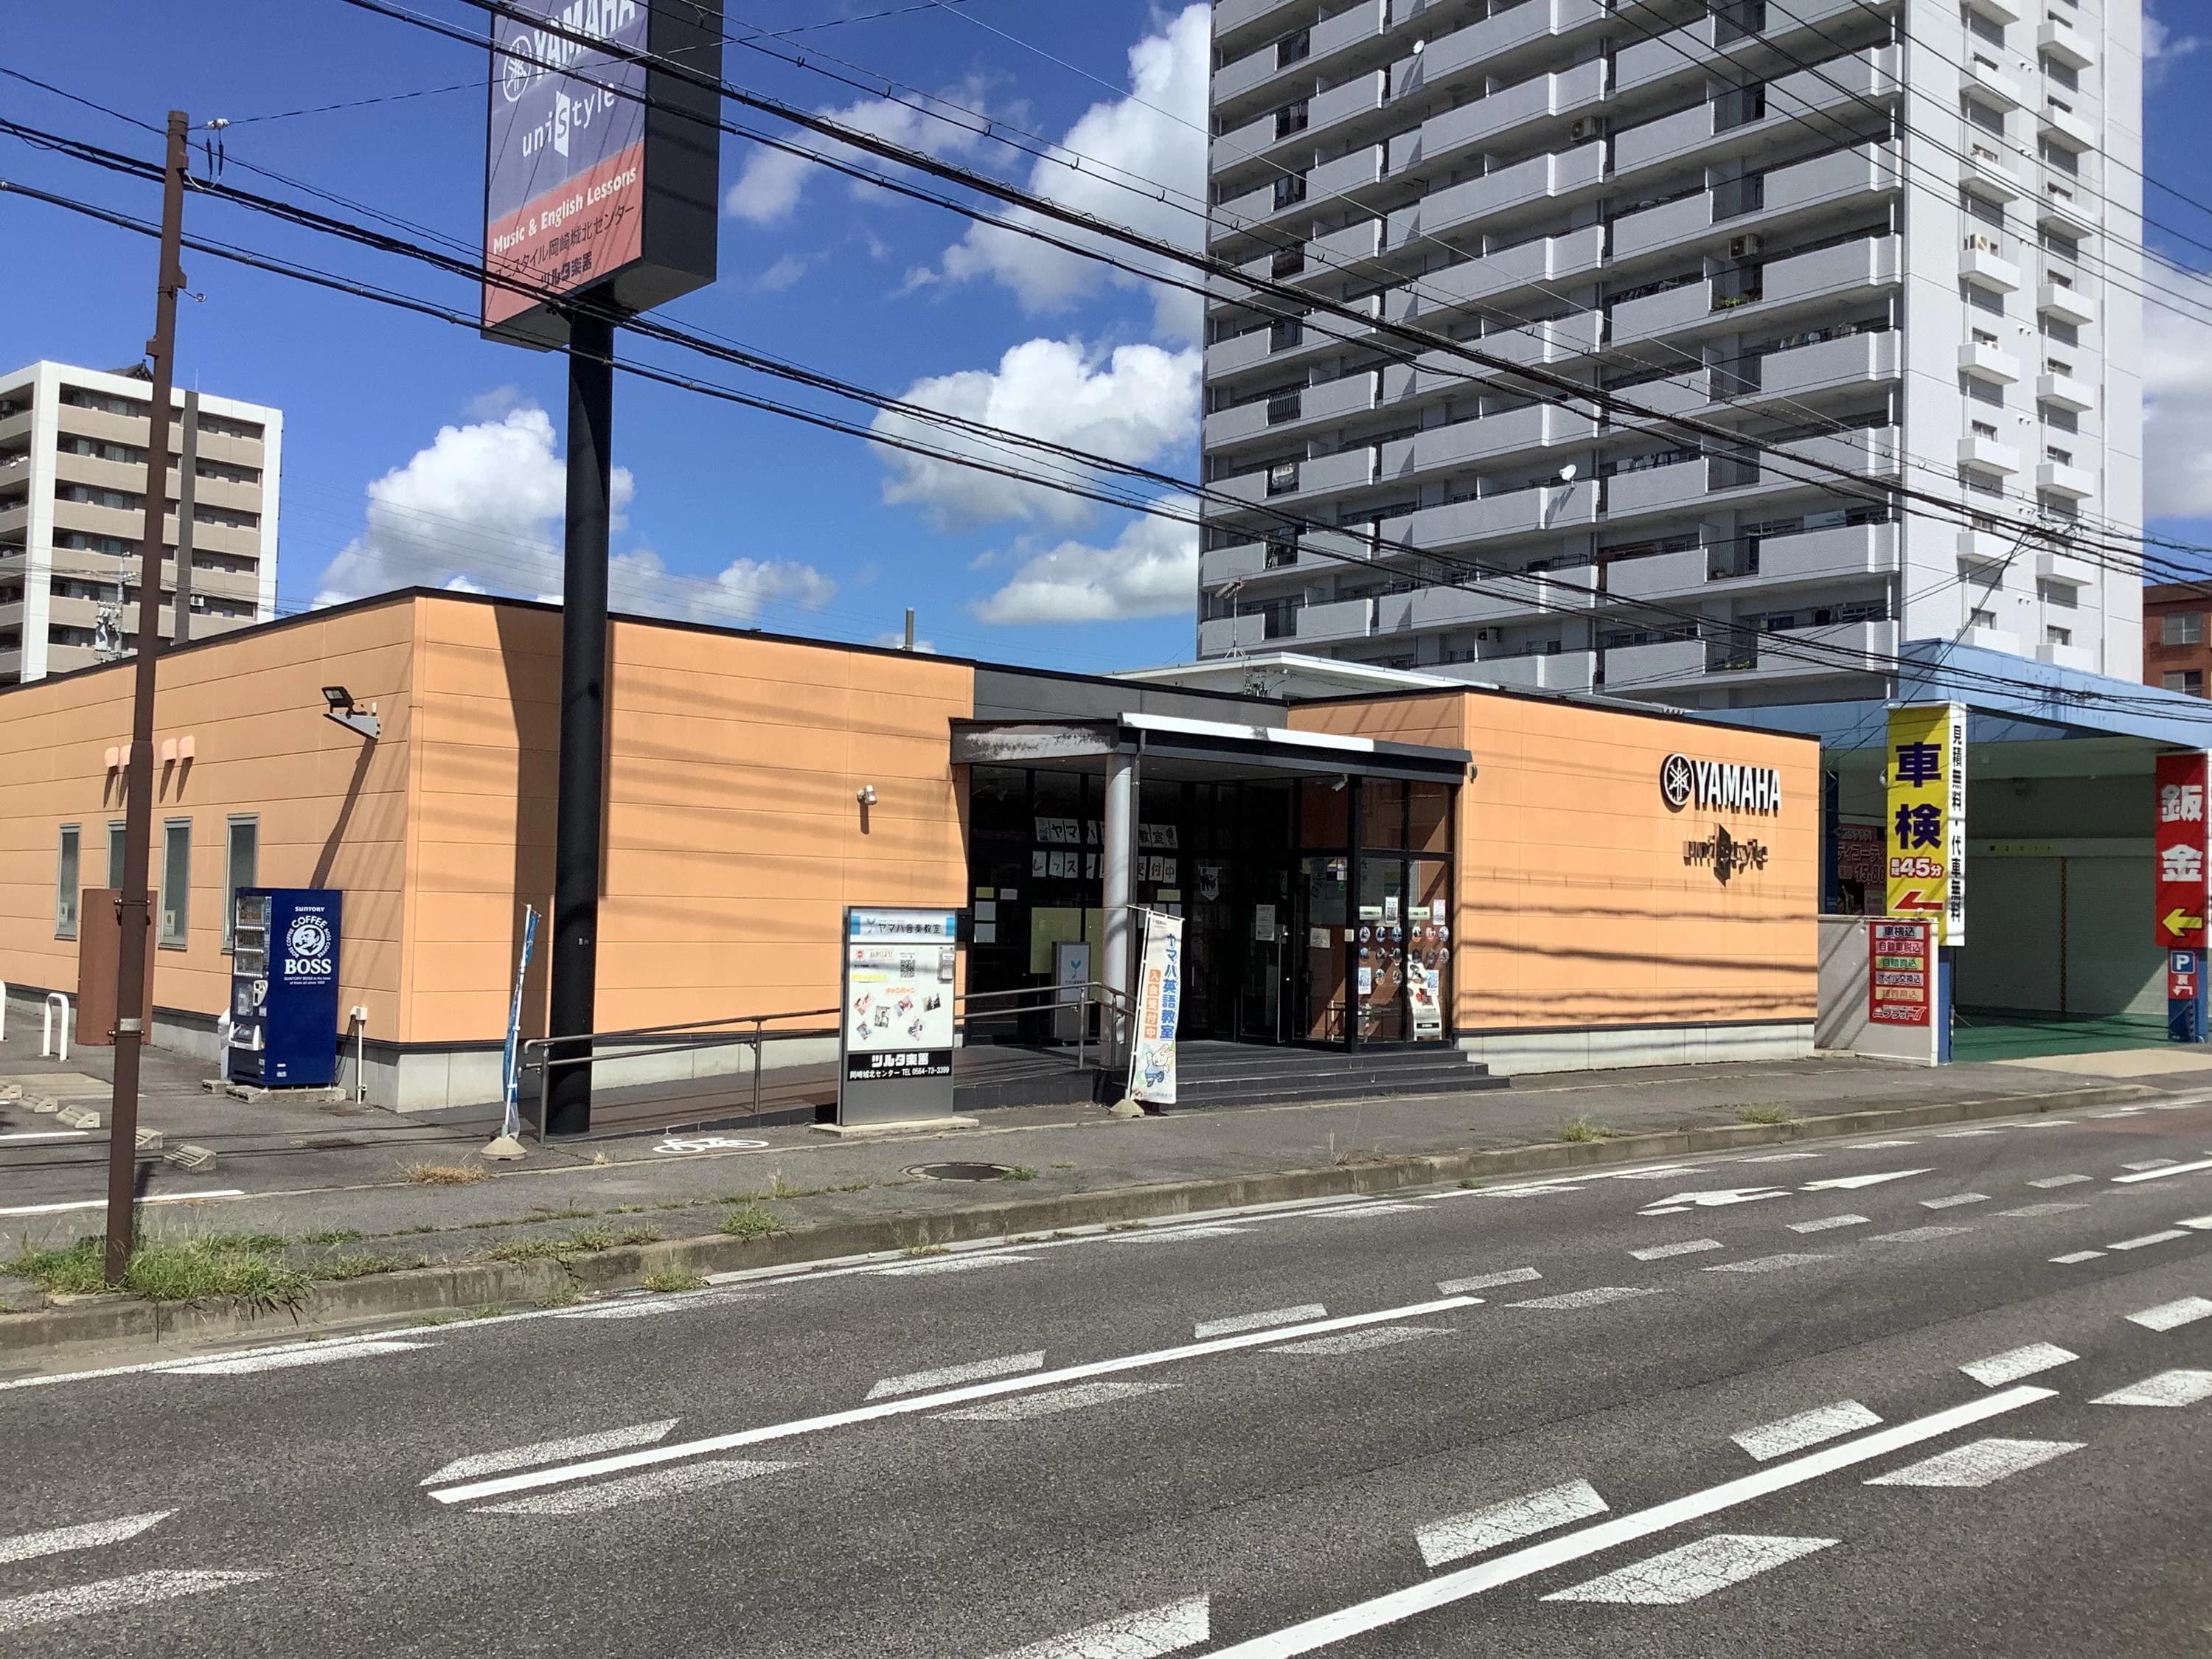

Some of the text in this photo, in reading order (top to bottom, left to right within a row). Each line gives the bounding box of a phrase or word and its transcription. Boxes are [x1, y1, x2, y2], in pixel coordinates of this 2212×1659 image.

[534, 0, 636, 83] YAMAHA
[493, 167, 637, 255] Music & English Lessons
[1694, 760, 1782, 812] YAMAHA
[1895, 742, 1942, 850] 車検
[2161, 784, 2203, 883] 鈑金
[291, 915, 328, 929] COFFEE
[877, 923, 942, 934] ヤマハ音楽教室
[1883, 926, 1916, 938] 車検込
[1879, 941, 1921, 953] 自動車税込
[284, 959, 332, 975] BOSS
[2176, 954, 2190, 970] P
[1159, 933, 1179, 1040] ヤマハ英語教室
[1877, 973, 1921, 985] オイル交換込
[1145, 970, 1161, 1038] 入会受付中
[872, 1052, 929, 1068] ツルタ楽器
